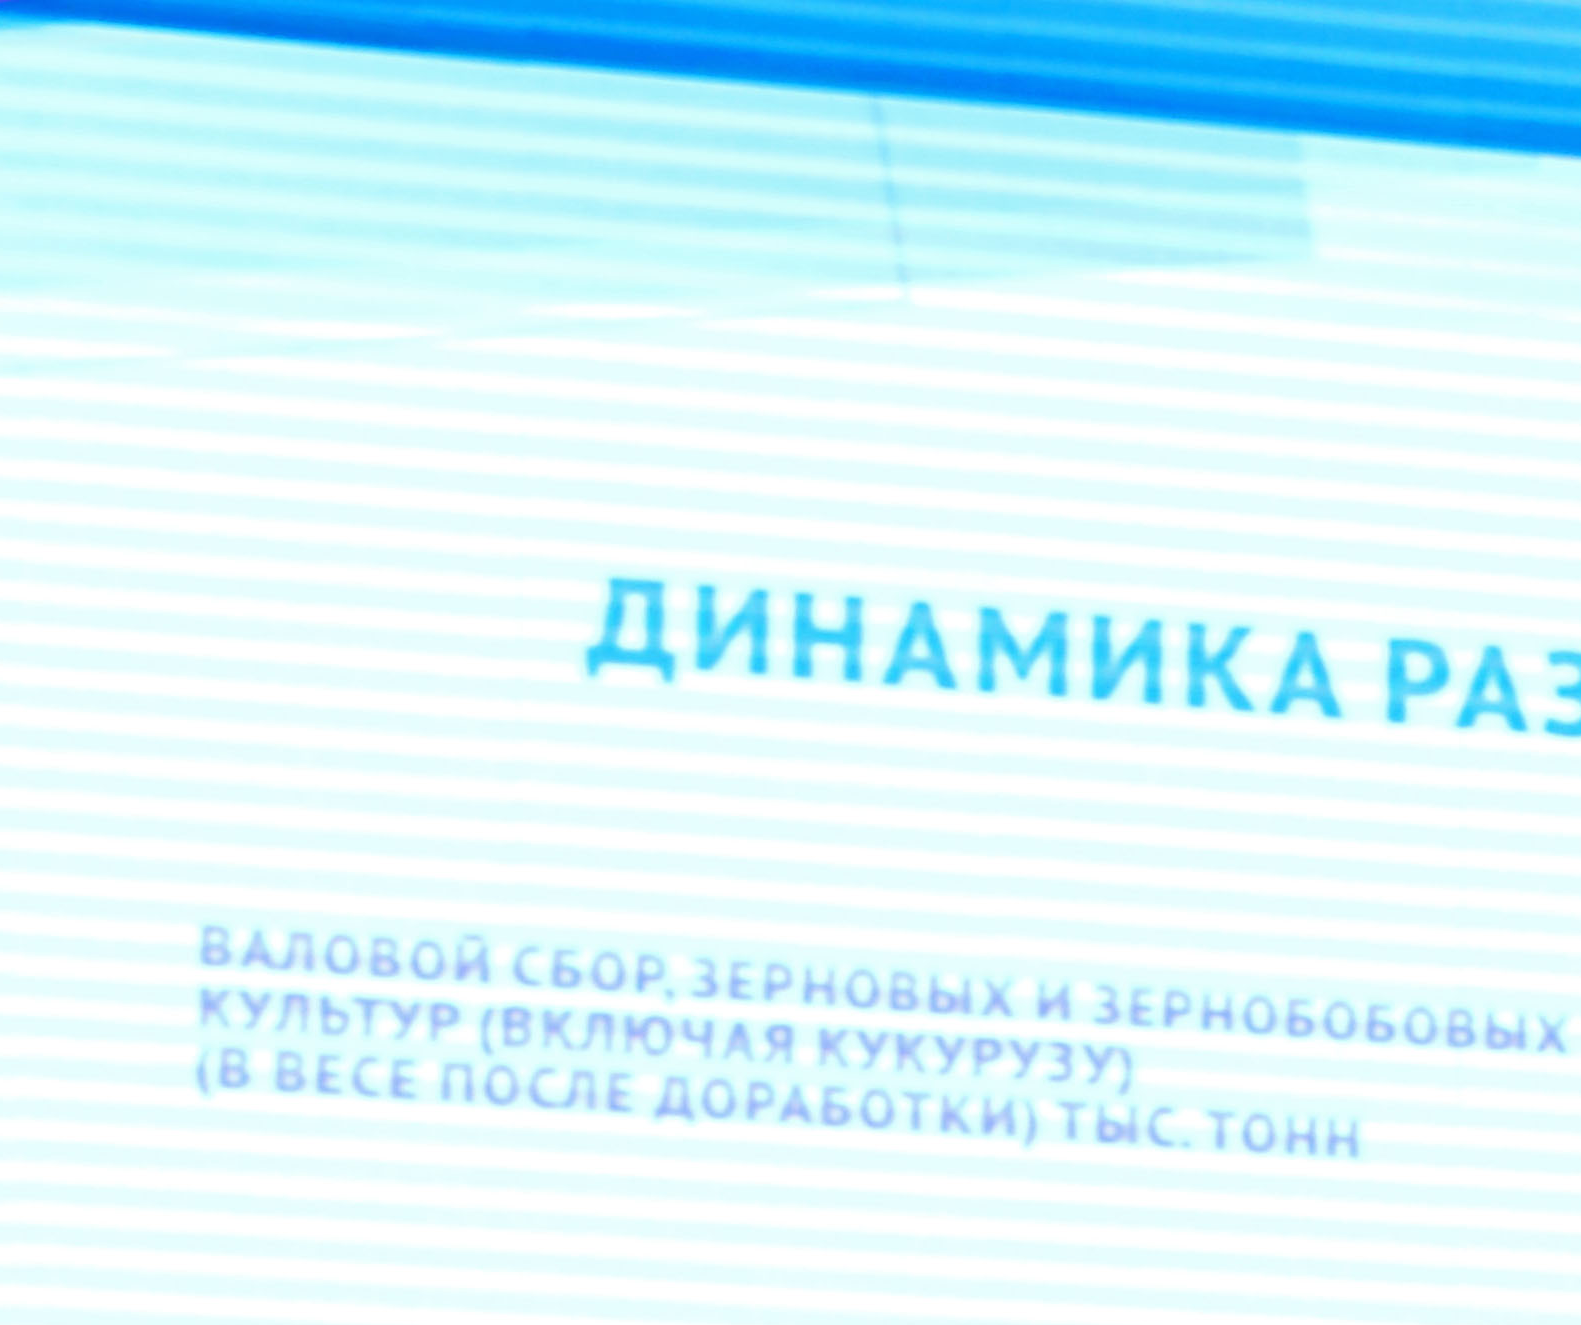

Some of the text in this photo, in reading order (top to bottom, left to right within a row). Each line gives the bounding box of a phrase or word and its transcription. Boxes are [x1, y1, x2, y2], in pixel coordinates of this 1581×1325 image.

[585, 576, 1343, 720] ДИНАМИКА
[199, 987, 1135, 1095] КУЛЬТУР (ВКЛЮЧАЯ КУКУРУЗУ)
[200, 924, 1570, 1054] ВАЛОВОЙ СБОР, ЗЕРНОВЫХ И ЗЕРНОБОБОВЫХ
[195, 1046, 1361, 1158] (В ВЕСЕ ПОСЛЕ ДОРАБОТКИ) ТЫС. ТОНН
